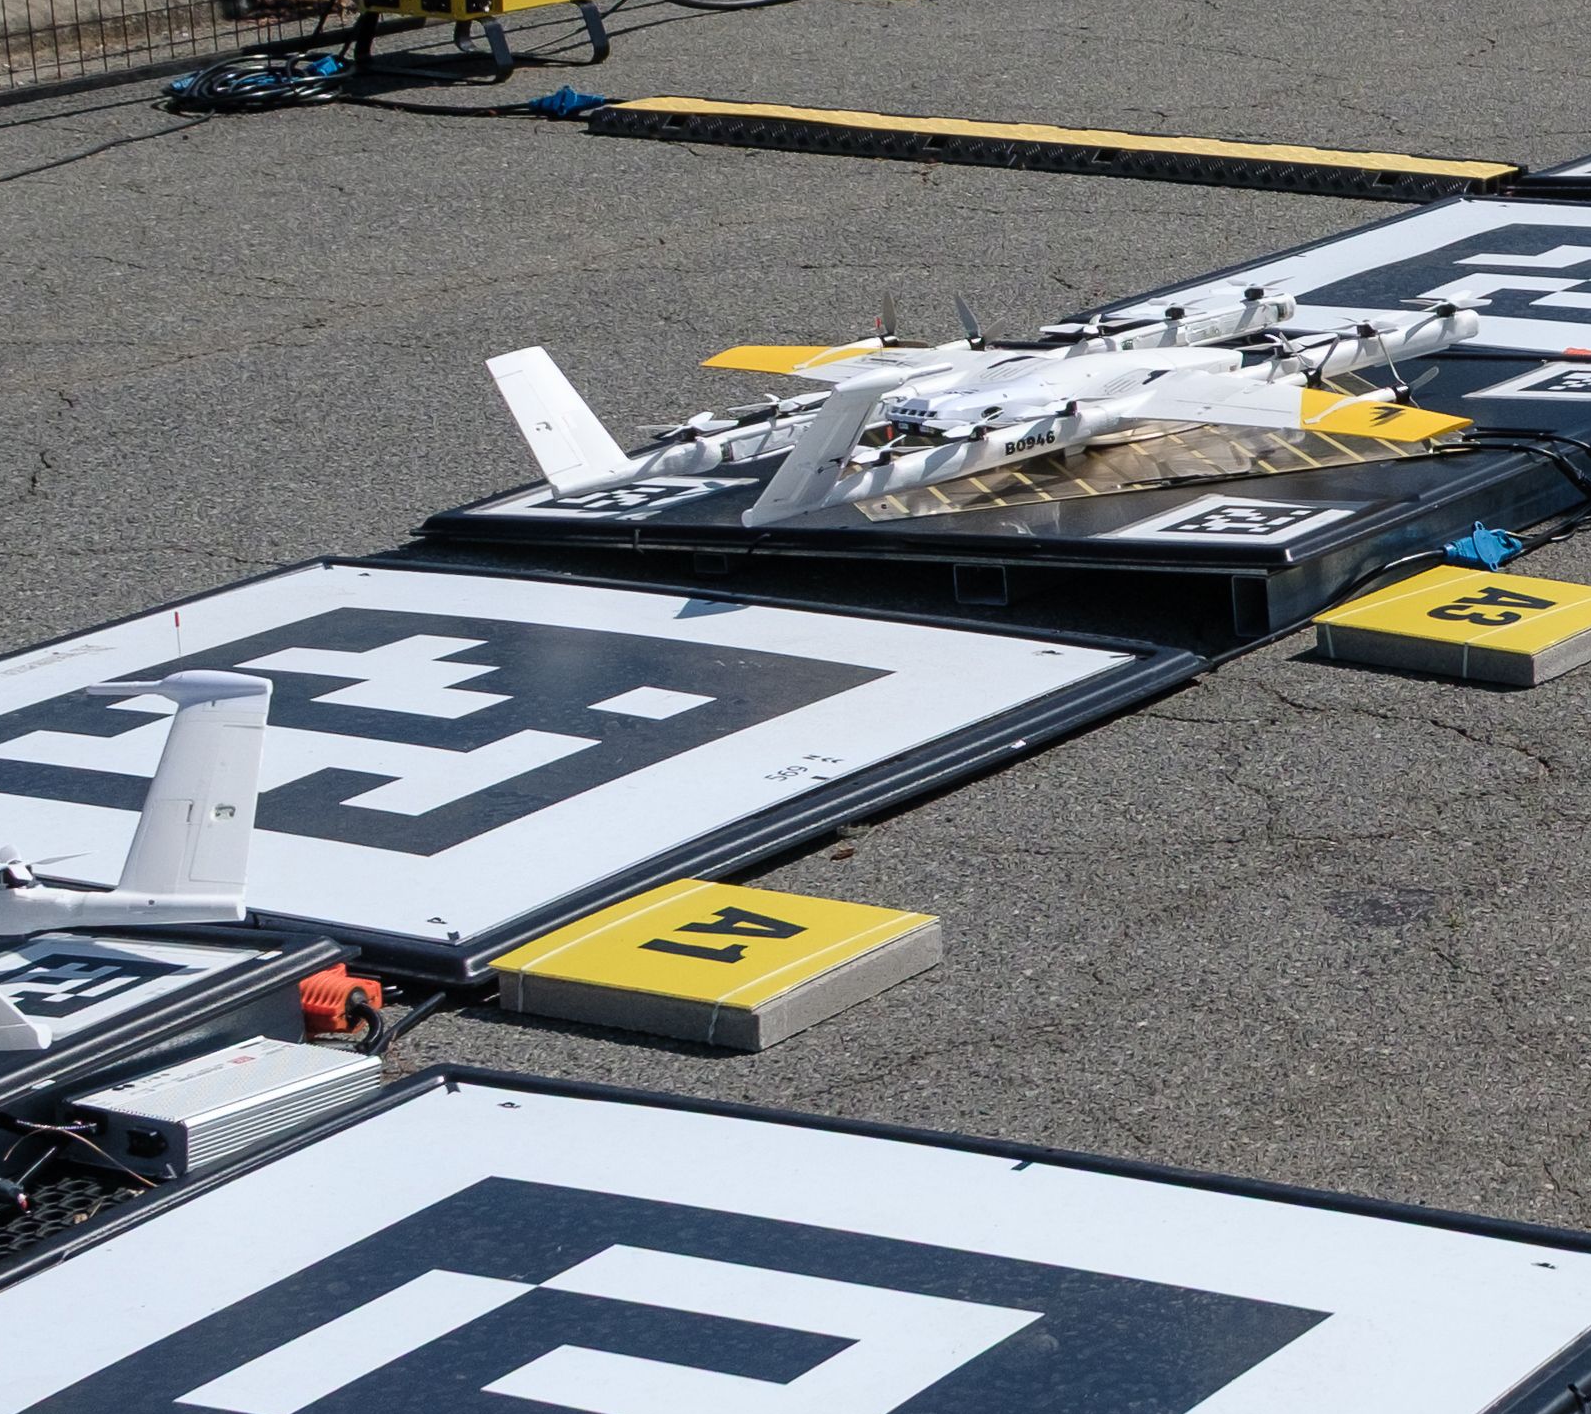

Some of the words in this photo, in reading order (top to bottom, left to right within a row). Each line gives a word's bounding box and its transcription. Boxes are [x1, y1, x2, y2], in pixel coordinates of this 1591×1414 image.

[1005, 432, 1055, 455] B0946
[1427, 586, 1558, 626] A3
[765, 765, 808, 782] 569
[636, 906, 809, 963] A1
